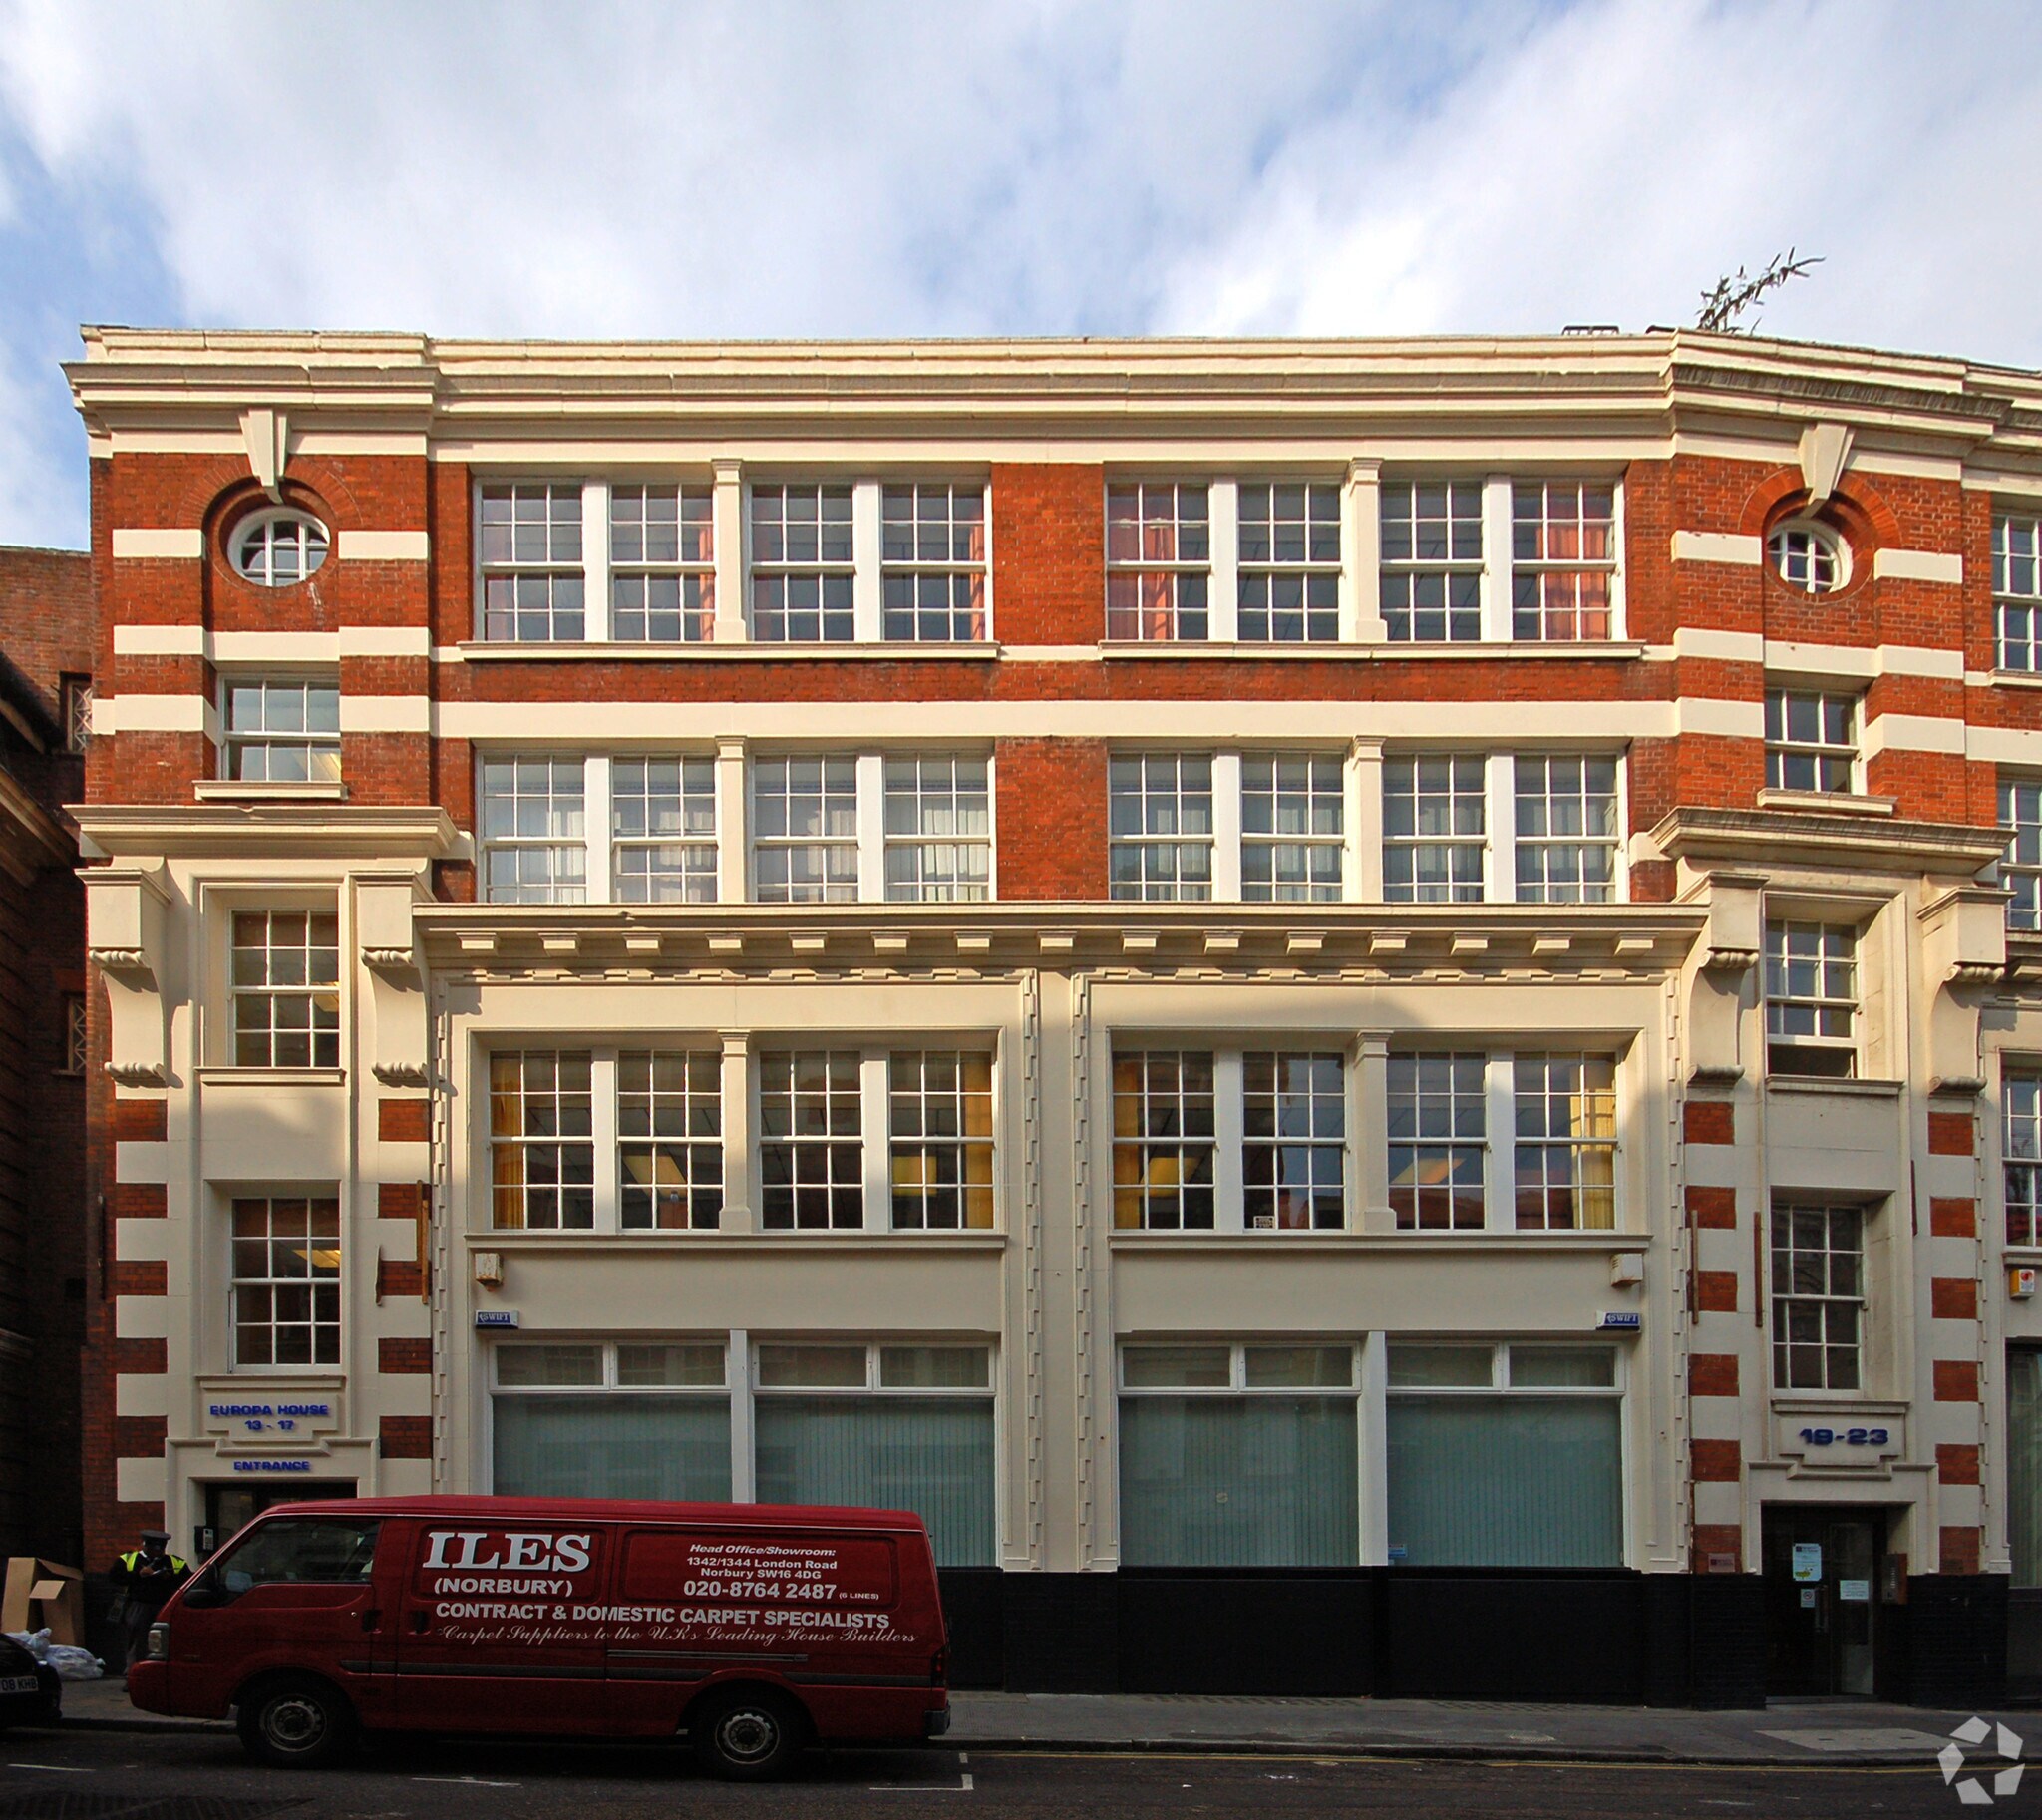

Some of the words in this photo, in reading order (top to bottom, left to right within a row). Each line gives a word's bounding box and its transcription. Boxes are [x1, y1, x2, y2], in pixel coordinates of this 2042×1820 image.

[482, 1312, 510, 1322] SWIFT
[1609, 1314, 1637, 1323] SWIFT
[209, 1404, 273, 1416] EUROPA
[277, 1405, 329, 1416] HOUSE
[244, 1420, 262, 1430] 13
[277, 1420, 295, 1430] 17
[1799, 1428, 1889, 1445] 19-23
[233, 1461, 311, 1471] ENTRANCE
[422, 1531, 591, 1573] ILES
[689, 1544, 724, 1554] Head
[725, 1545, 837, 1557] Office/Showroom:
[686, 1556, 752, 1568] 1342/1344
[754, 1558, 802, 1569] London
[805, 1560, 838, 1570] Road
[700, 1567, 754, 1580] Norbury
[757, 1569, 792, 1579] SW16
[794, 1570, 822, 1580] 4DG
[434, 1577, 573, 1597] (NORBURY)
[683, 1580, 781, 1598] 020-8764
[785, 1582, 838, 1600] 2487
[850, 1592, 879, 1601] LINES)
[436, 1602, 548, 1620] CONTRACT
[552, 1605, 567, 1621] &
[573, 1605, 675, 1623] DOMESTIC
[679, 1608, 760, 1625] CARPET
[764, 1611, 890, 1629] SPECIALISTS
[438, 1625, 502, 1645] Carpet
[507, 1625, 589, 1645] Suppliers
[594, 1626, 611, 1640] to
[614, 1626, 643, 1640] the
[703, 1626, 781, 1646] Leading
[781, 1627, 836, 1642] House
[839, 1628, 918, 1643] Builders
